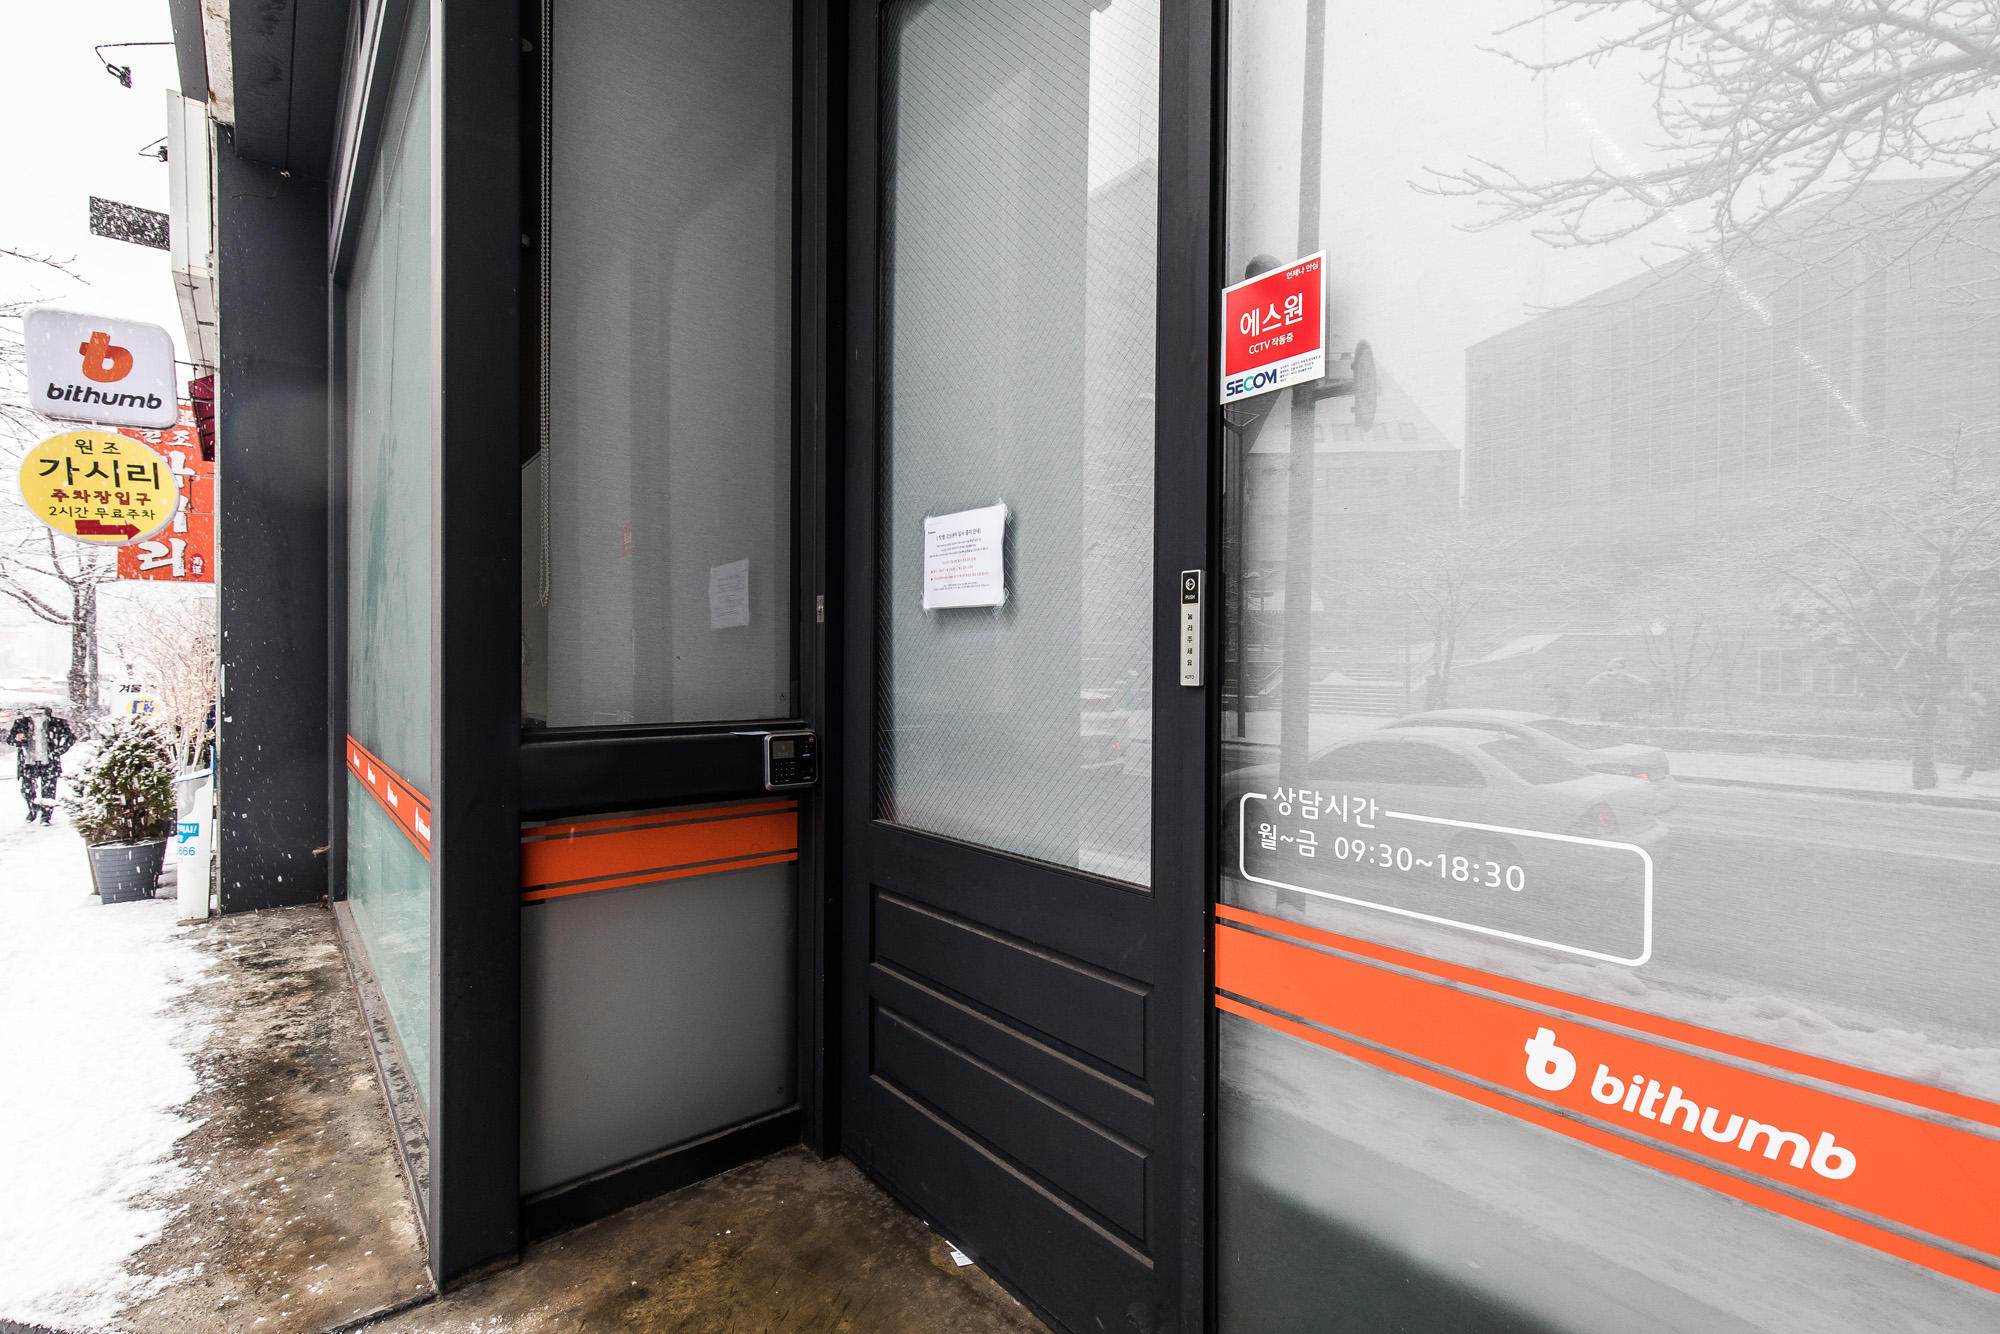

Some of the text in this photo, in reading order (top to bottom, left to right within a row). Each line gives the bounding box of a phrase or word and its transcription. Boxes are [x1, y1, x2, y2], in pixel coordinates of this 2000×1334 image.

[1286, 260, 1319, 280] 언제나 안심
[1239, 292, 1303, 337] 에스원
[1248, 331, 1295, 355] CCTV 작동중
[46, 382, 162, 410] bithumb
[1226, 368, 1278, 397] SECOM
[38, 456, 160, 490] 가시리
[50, 488, 152, 506] 주차장입구
[48, 506, 156, 520] 2시간 무료주차
[1272, 786, 1380, 829] 상담시간
[1257, 822, 1526, 892] 월~금 09:30~18:30
[1590, 1063, 1857, 1180] bithumb
